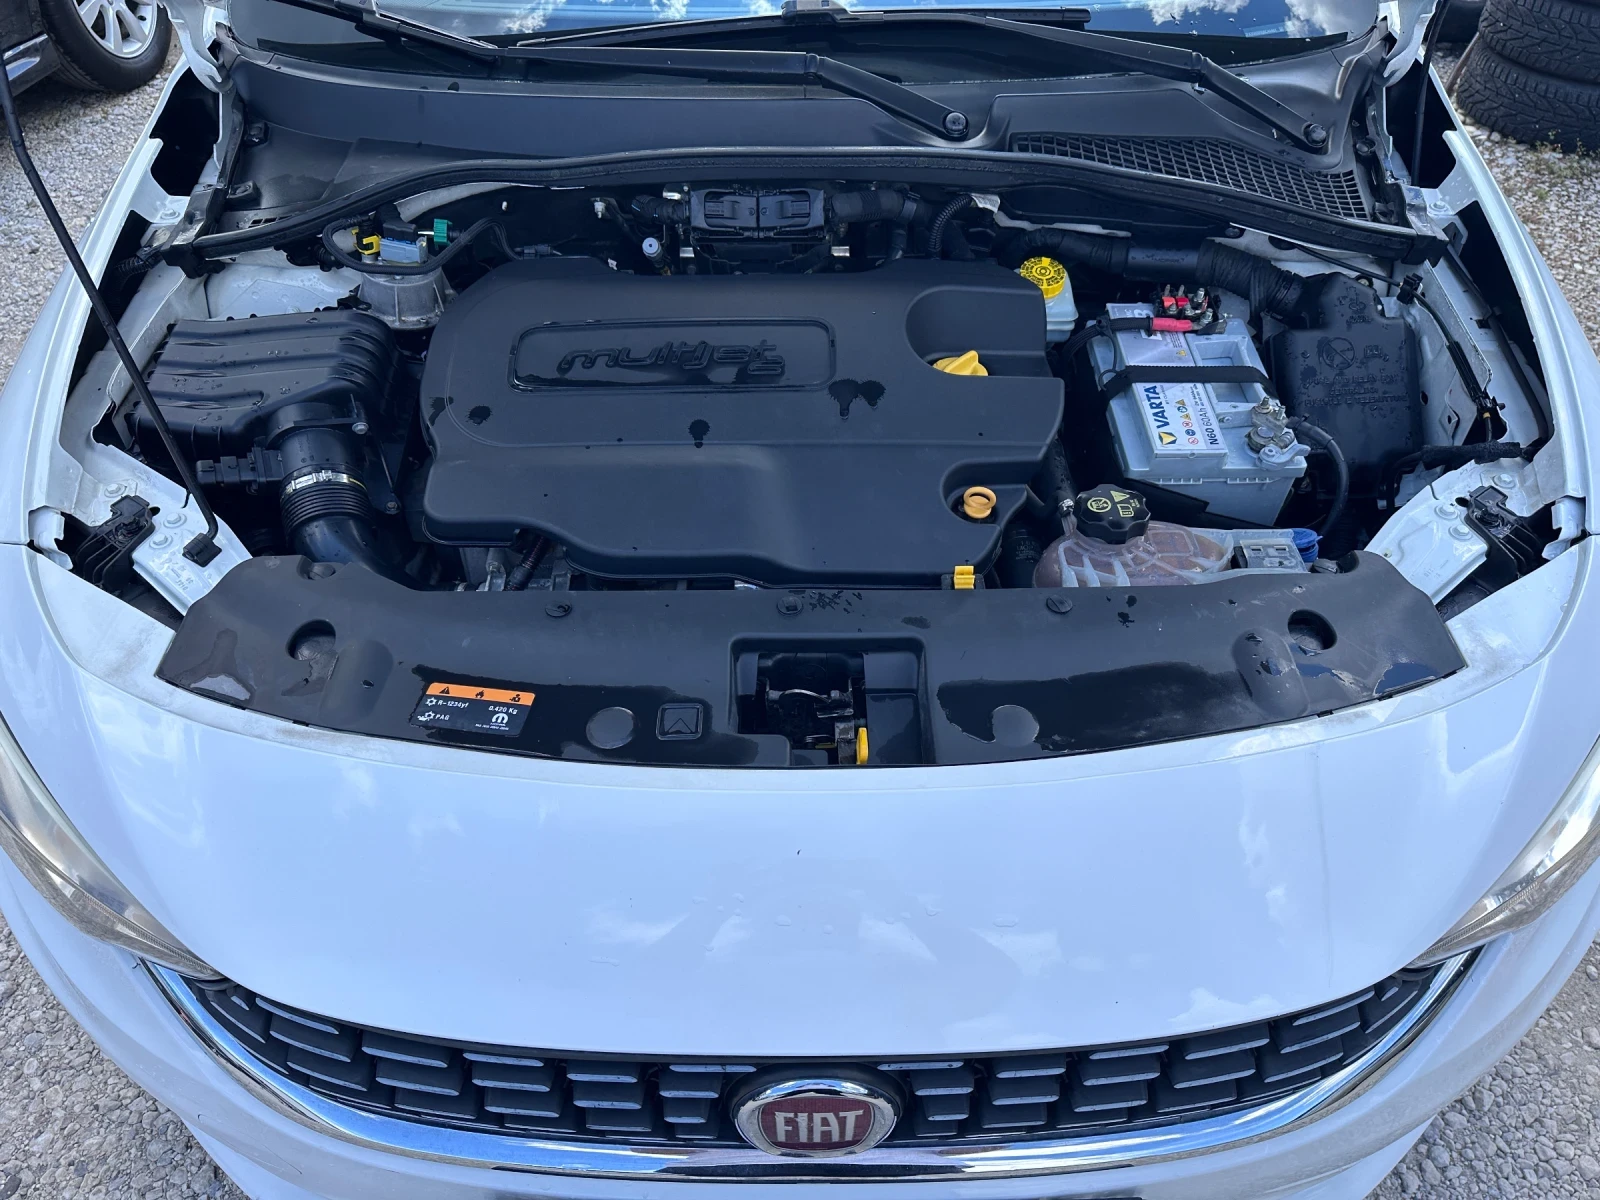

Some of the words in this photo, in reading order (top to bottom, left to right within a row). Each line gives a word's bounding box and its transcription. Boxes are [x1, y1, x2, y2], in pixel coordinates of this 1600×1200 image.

[1144, 385, 1170, 429] VARTA
[1204, 427, 1220, 445] N60
[438, 700, 469, 708] R-1234yf
[775, 1109, 864, 1143] FIAT
